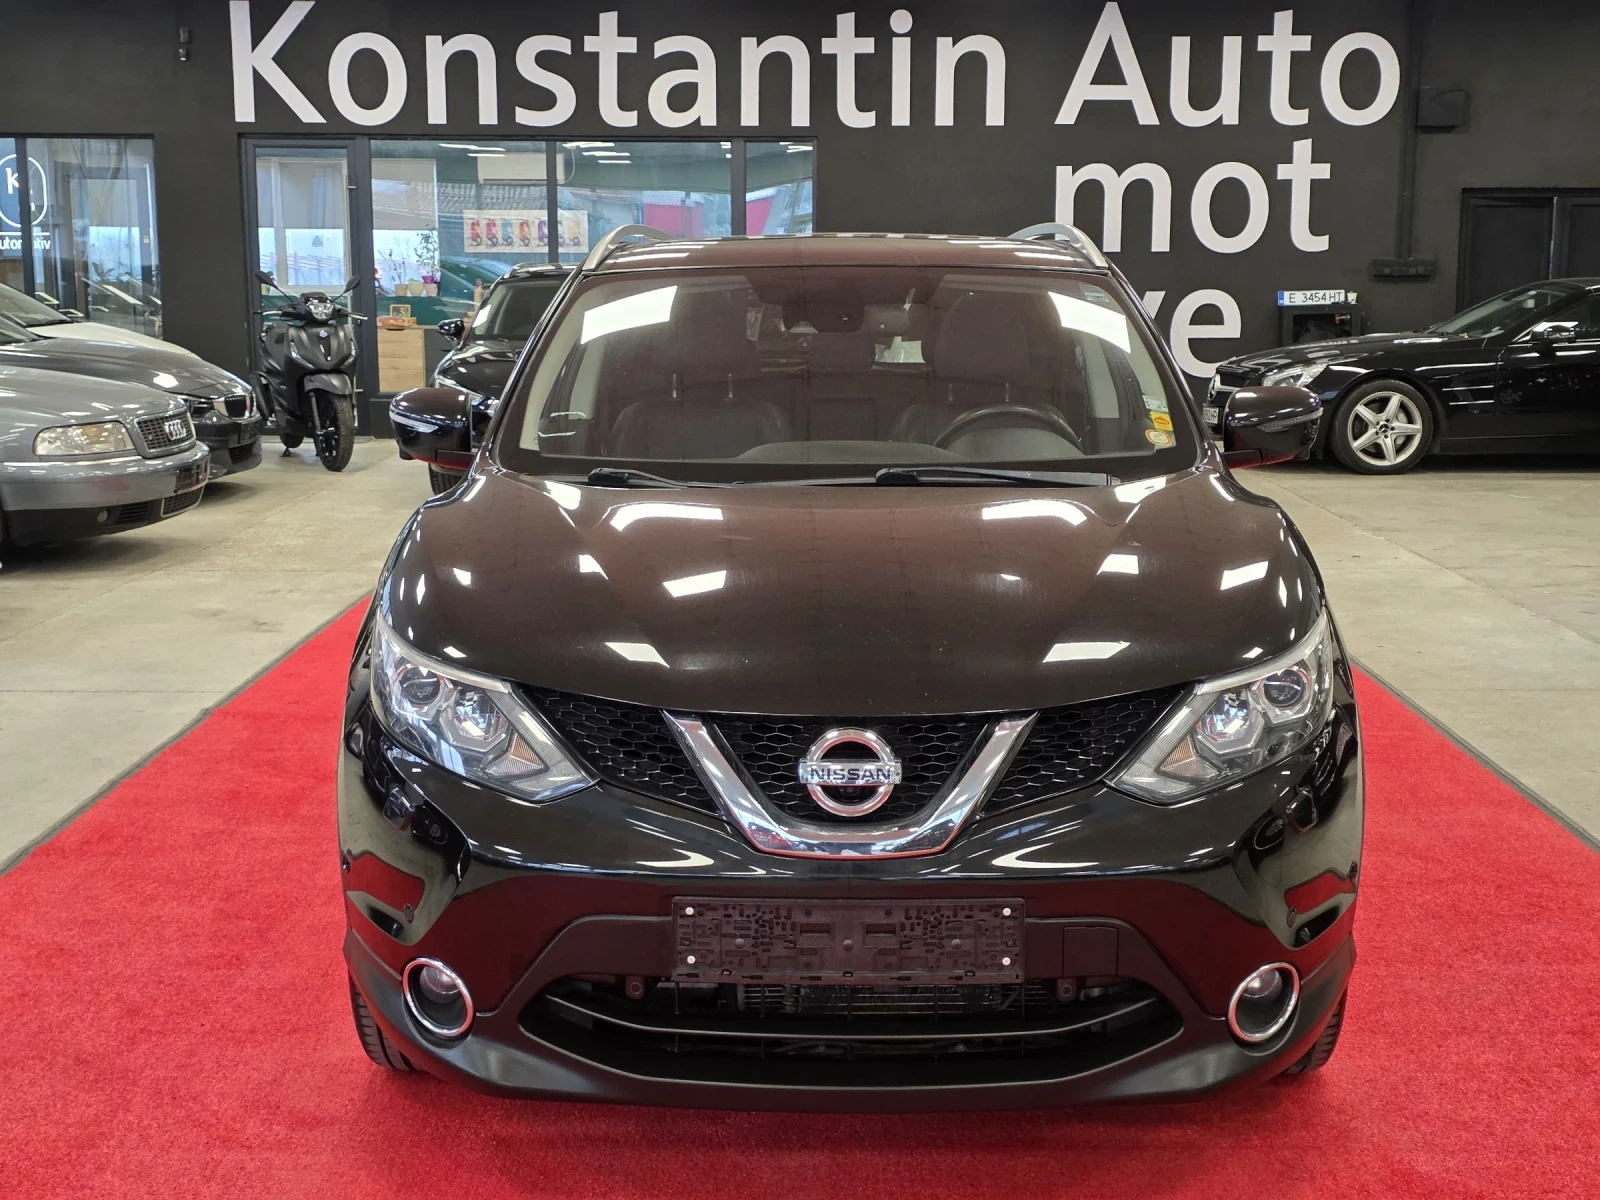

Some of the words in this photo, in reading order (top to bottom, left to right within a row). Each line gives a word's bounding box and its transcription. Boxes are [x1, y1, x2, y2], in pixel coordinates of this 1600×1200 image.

[229, 0, 1006, 128] Konstantin
[1055, 1, 1400, 128] Auto
[1055, 138, 1331, 254] mot
[810, 767, 891, 781] NISSAN
